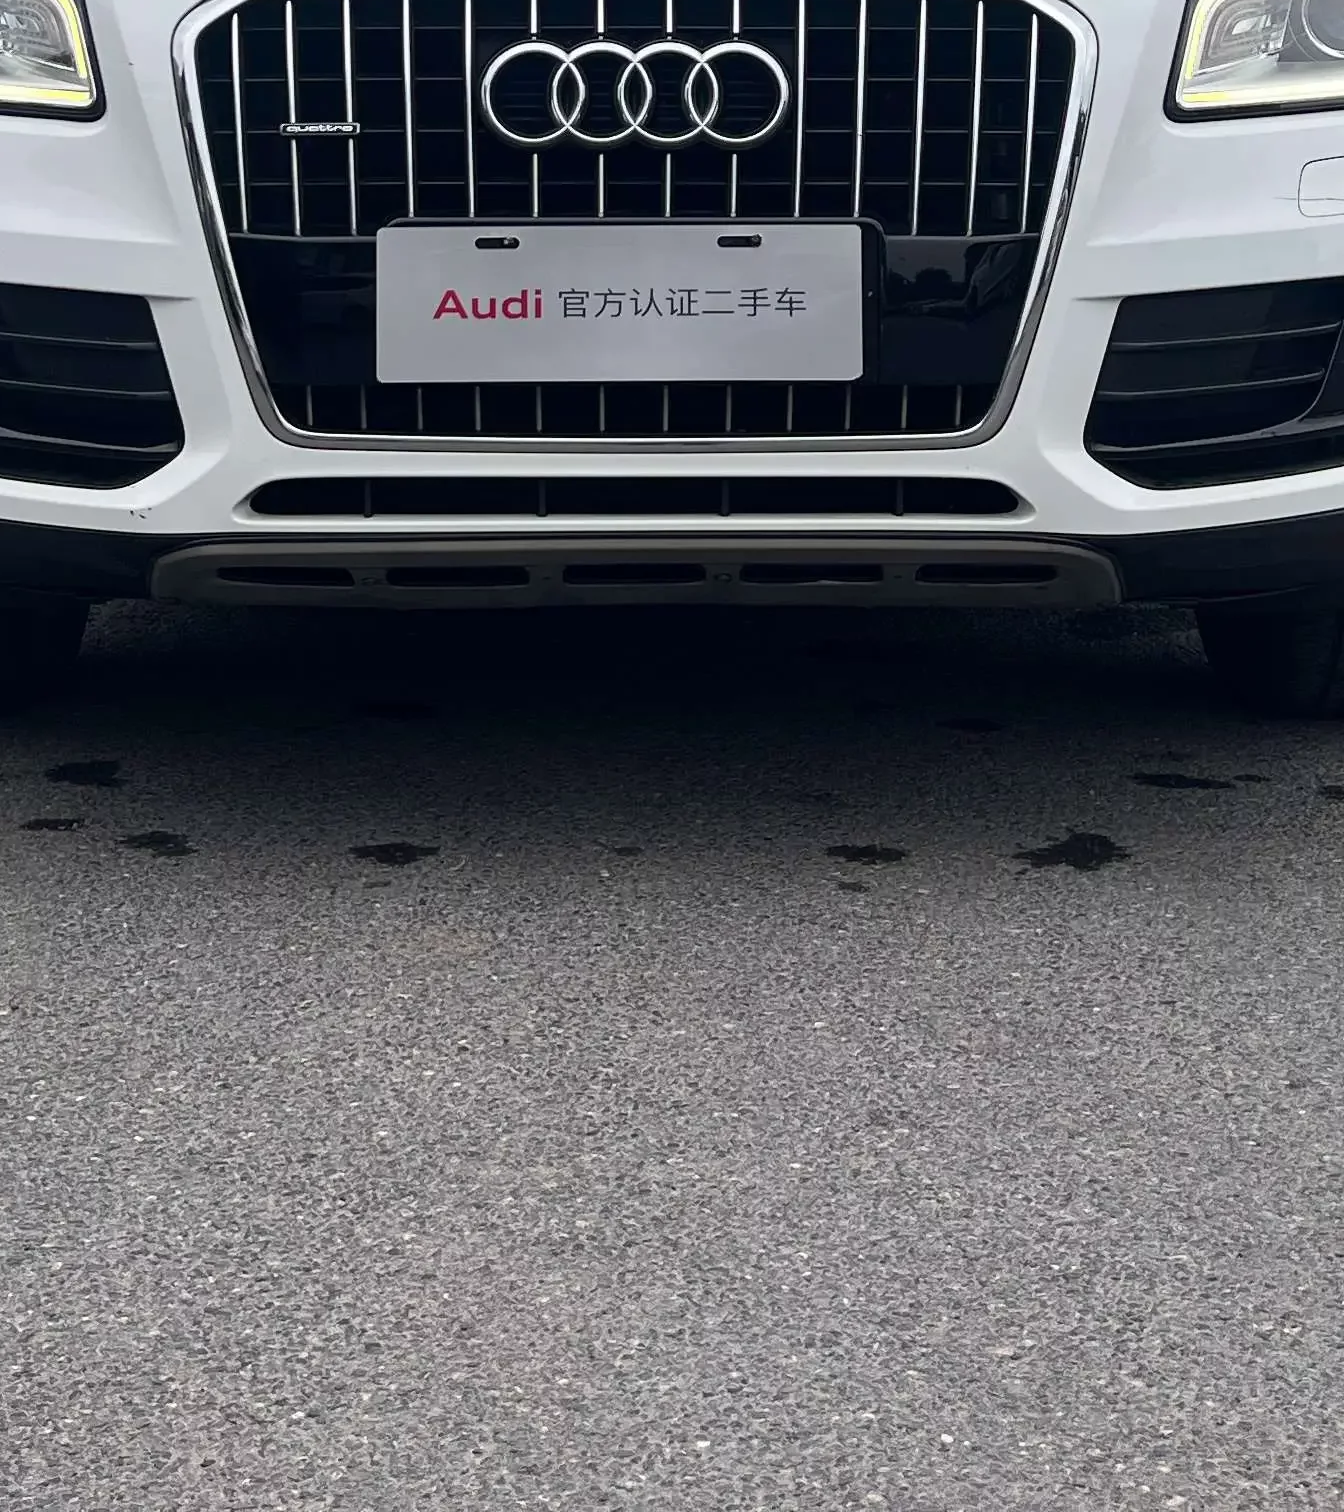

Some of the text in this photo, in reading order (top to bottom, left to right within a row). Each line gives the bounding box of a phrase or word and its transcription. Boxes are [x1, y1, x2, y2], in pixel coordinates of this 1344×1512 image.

[285, 124, 354, 134] quattro
[432, 288, 807, 320] Audi 官方认证二手车
